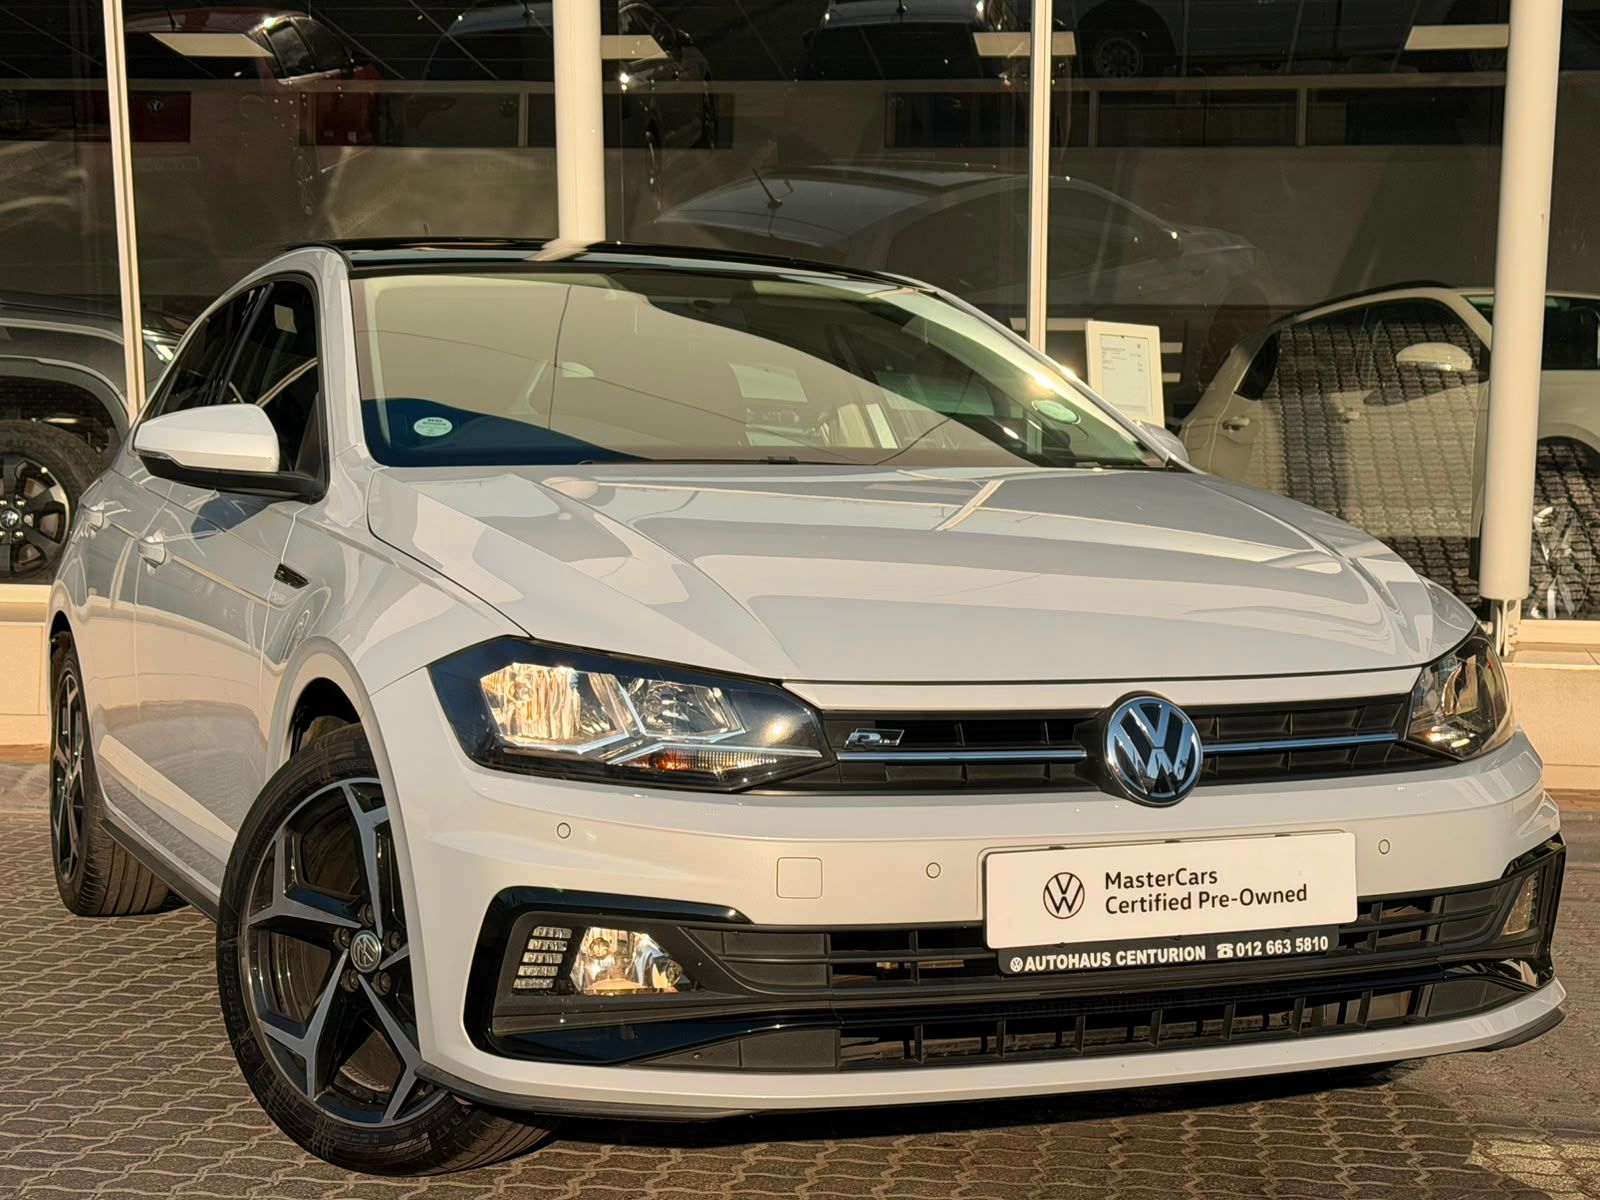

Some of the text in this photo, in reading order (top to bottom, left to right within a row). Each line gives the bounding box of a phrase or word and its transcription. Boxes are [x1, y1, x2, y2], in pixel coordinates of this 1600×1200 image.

[1105, 867, 1218, 890] MasterCars
[1105, 883, 1307, 915] Certified Pre-Owned
[1024, 951, 1112, 972] AUTOHAUS
[1115, 945, 1206, 966] CENTURION
[1235, 940, 1263, 958] 012
[1265, 938, 1292, 955] 663
[1295, 935, 1329, 953] 5810
